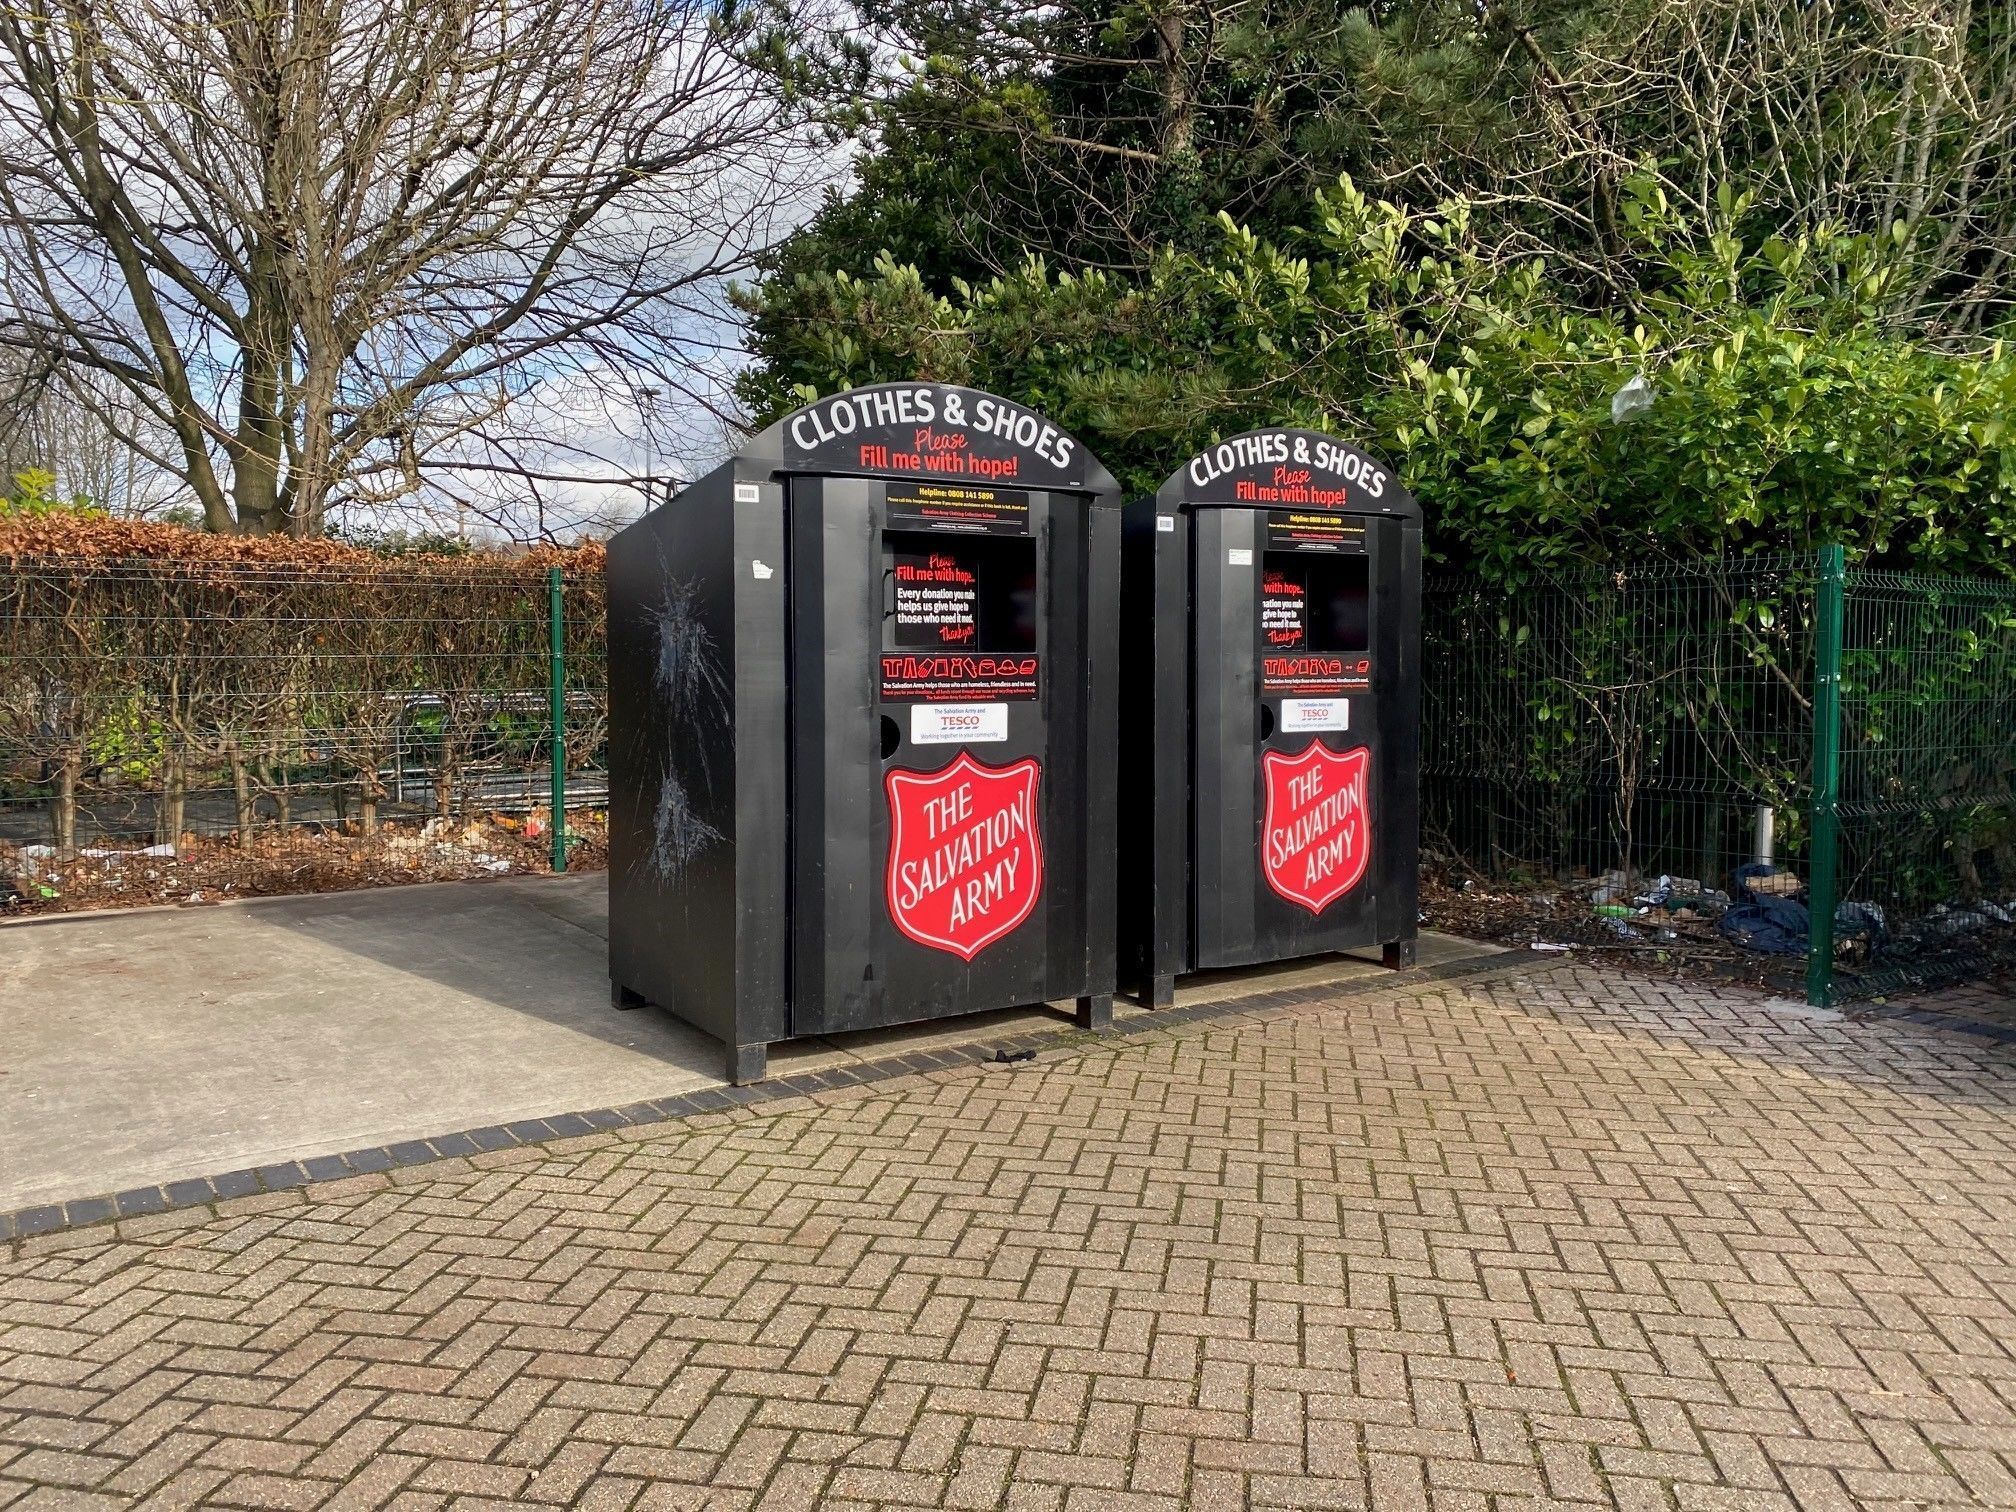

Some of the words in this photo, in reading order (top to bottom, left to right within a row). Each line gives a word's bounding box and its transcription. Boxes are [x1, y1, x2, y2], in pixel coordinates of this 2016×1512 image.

[791, 389, 936, 450] CLOTHES
[943, 394, 968, 427] &
[972, 400, 1075, 468] SHOES
[914, 425, 968, 453] Please
[860, 445, 888, 469] Fill
[892, 453, 920, 471] me
[924, 451, 964, 473] with
[968, 452, 1018, 480] hope!
[1190, 434, 1289, 487] CLOTHES
[1293, 437, 1311, 465] &
[1314, 441, 1387, 498] SHOES
[1274, 464, 1311, 486] Please
[919, 487, 947, 498] Helpline:
[948, 489, 964, 498] 0808
[965, 491, 977, 499] 141
[978, 492, 994, 500] 5890
[1236, 482, 1256, 500] Fill
[1258, 486, 1278, 502] me
[1280, 485, 1308, 503] with
[1311, 487, 1346, 508] hope!
[897, 566, 914, 580] Fill
[917, 569, 934, 580] me
[935, 568, 954, 582] with
[898, 588, 921, 601] Every
[922, 588, 953, 599] donation
[954, 590, 964, 601] you
[1264, 582, 1283, 593] with
[897, 600, 922, 613] helps
[923, 603, 933, 611] us
[934, 601, 949, 613] give
[949, 601, 963, 615] hope
[1282, 600, 1291, 610] you
[897, 613, 923, 624] those
[923, 613, 940, 624] who
[941, 613, 956, 624] need
[957, 613, 962, 624] it
[1262, 609, 1277, 620] give
[1277, 609, 1291, 619] hope
[1269, 619, 1284, 628] need
[1285, 619, 1289, 628] it
[940, 624, 962, 641] Thank
[913, 682, 925, 690] Army
[925, 681, 938, 690] helps
[941, 716, 980, 726] TESCO
[1302, 709, 1329, 717] TESCO
[940, 732, 959, 740] together
[974, 731, 998, 739] community
[1288, 764, 1323, 811] THE
[923, 782, 973, 840] THE
[1272, 772, 1359, 869] SALVATION
[900, 790, 1025, 910] SALVATION
[1304, 820, 1355, 890] ARMY
[949, 846, 1020, 933] ARMY
